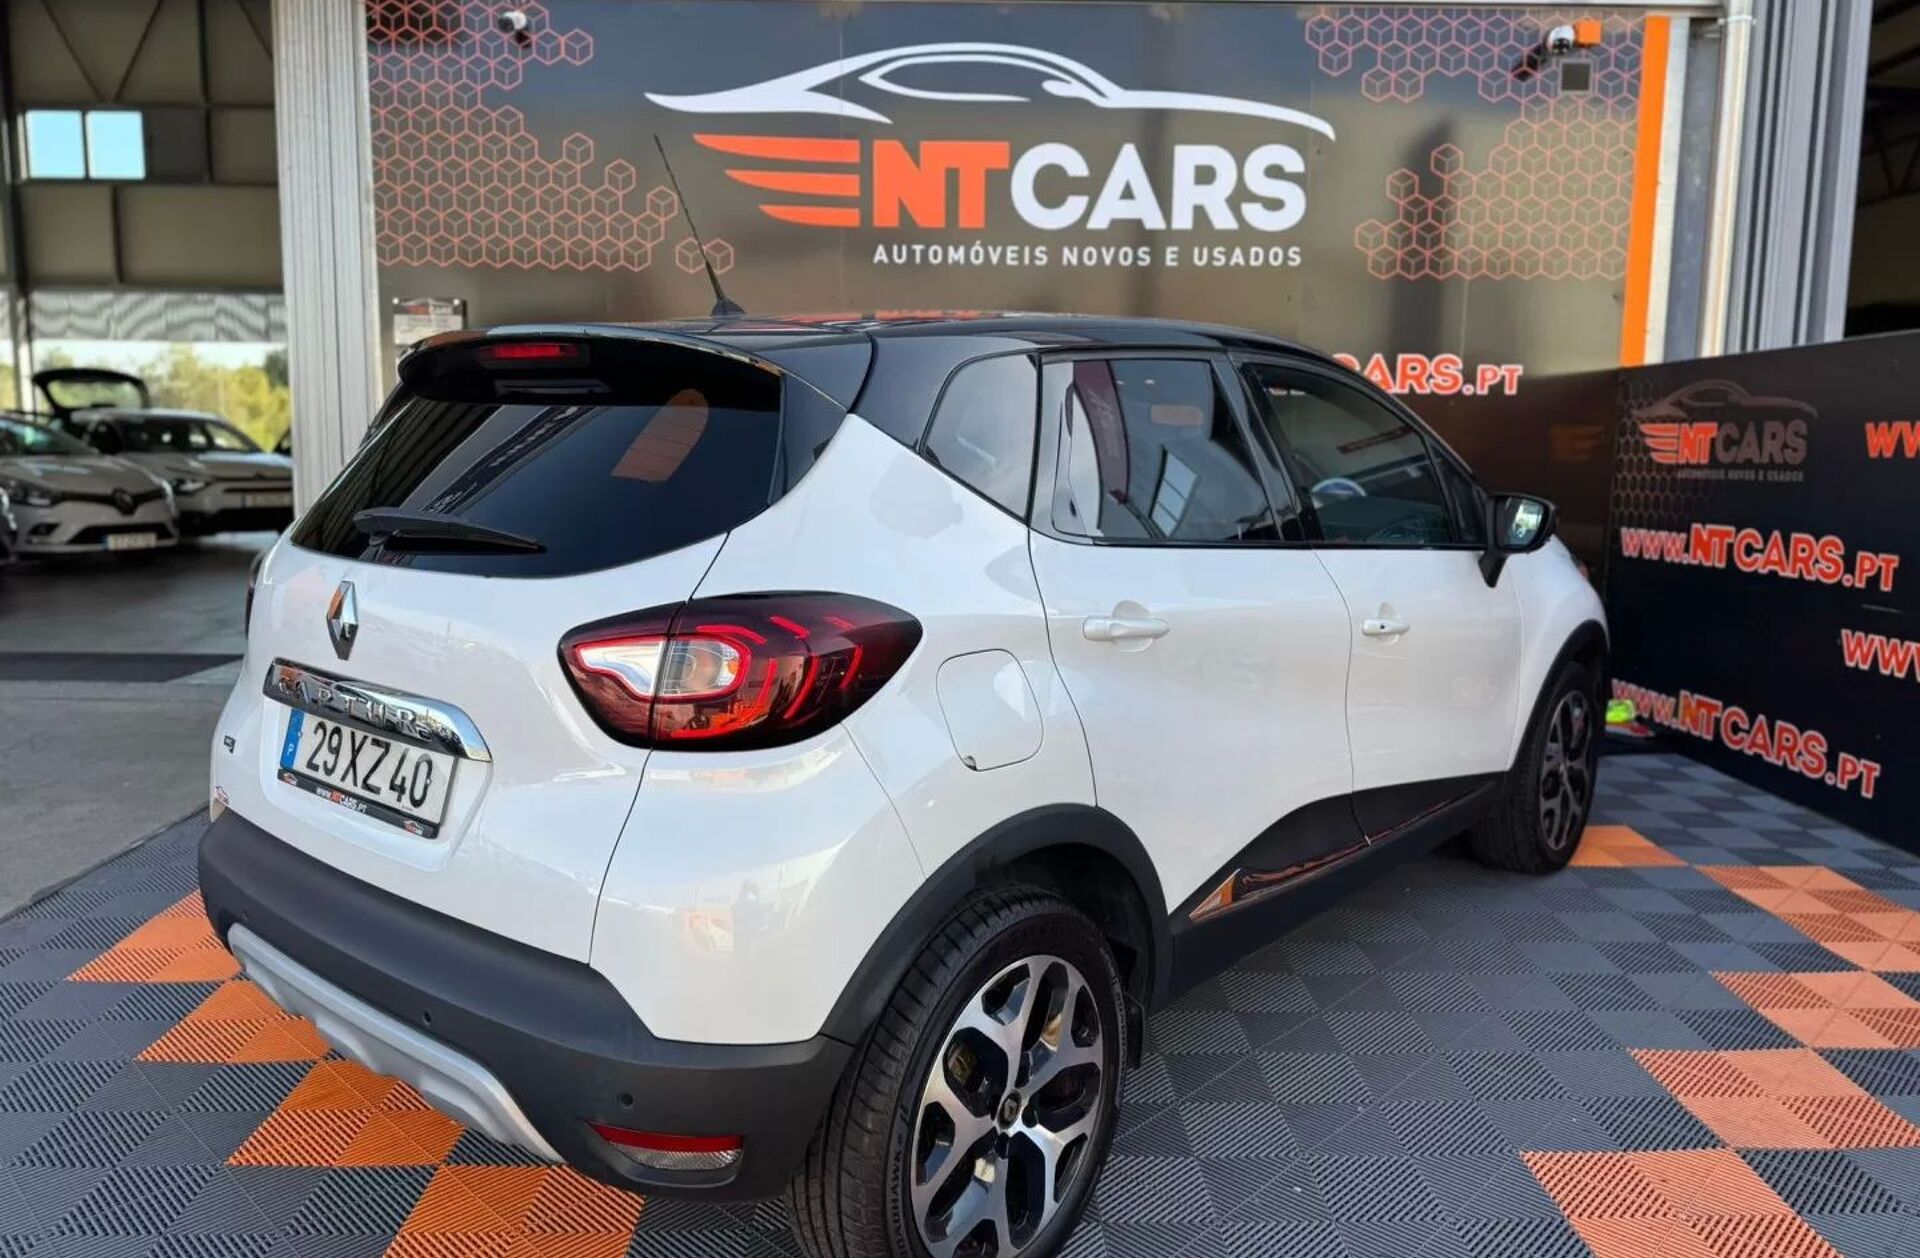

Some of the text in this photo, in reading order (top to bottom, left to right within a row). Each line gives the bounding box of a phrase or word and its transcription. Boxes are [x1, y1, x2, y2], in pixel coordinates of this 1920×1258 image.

[873, 140, 1306, 231] NTCARS
[873, 240, 1302, 266] AUTOMÓVEIS NOVOS E USADOS
[1678, 420, 1807, 465] NTCARS
